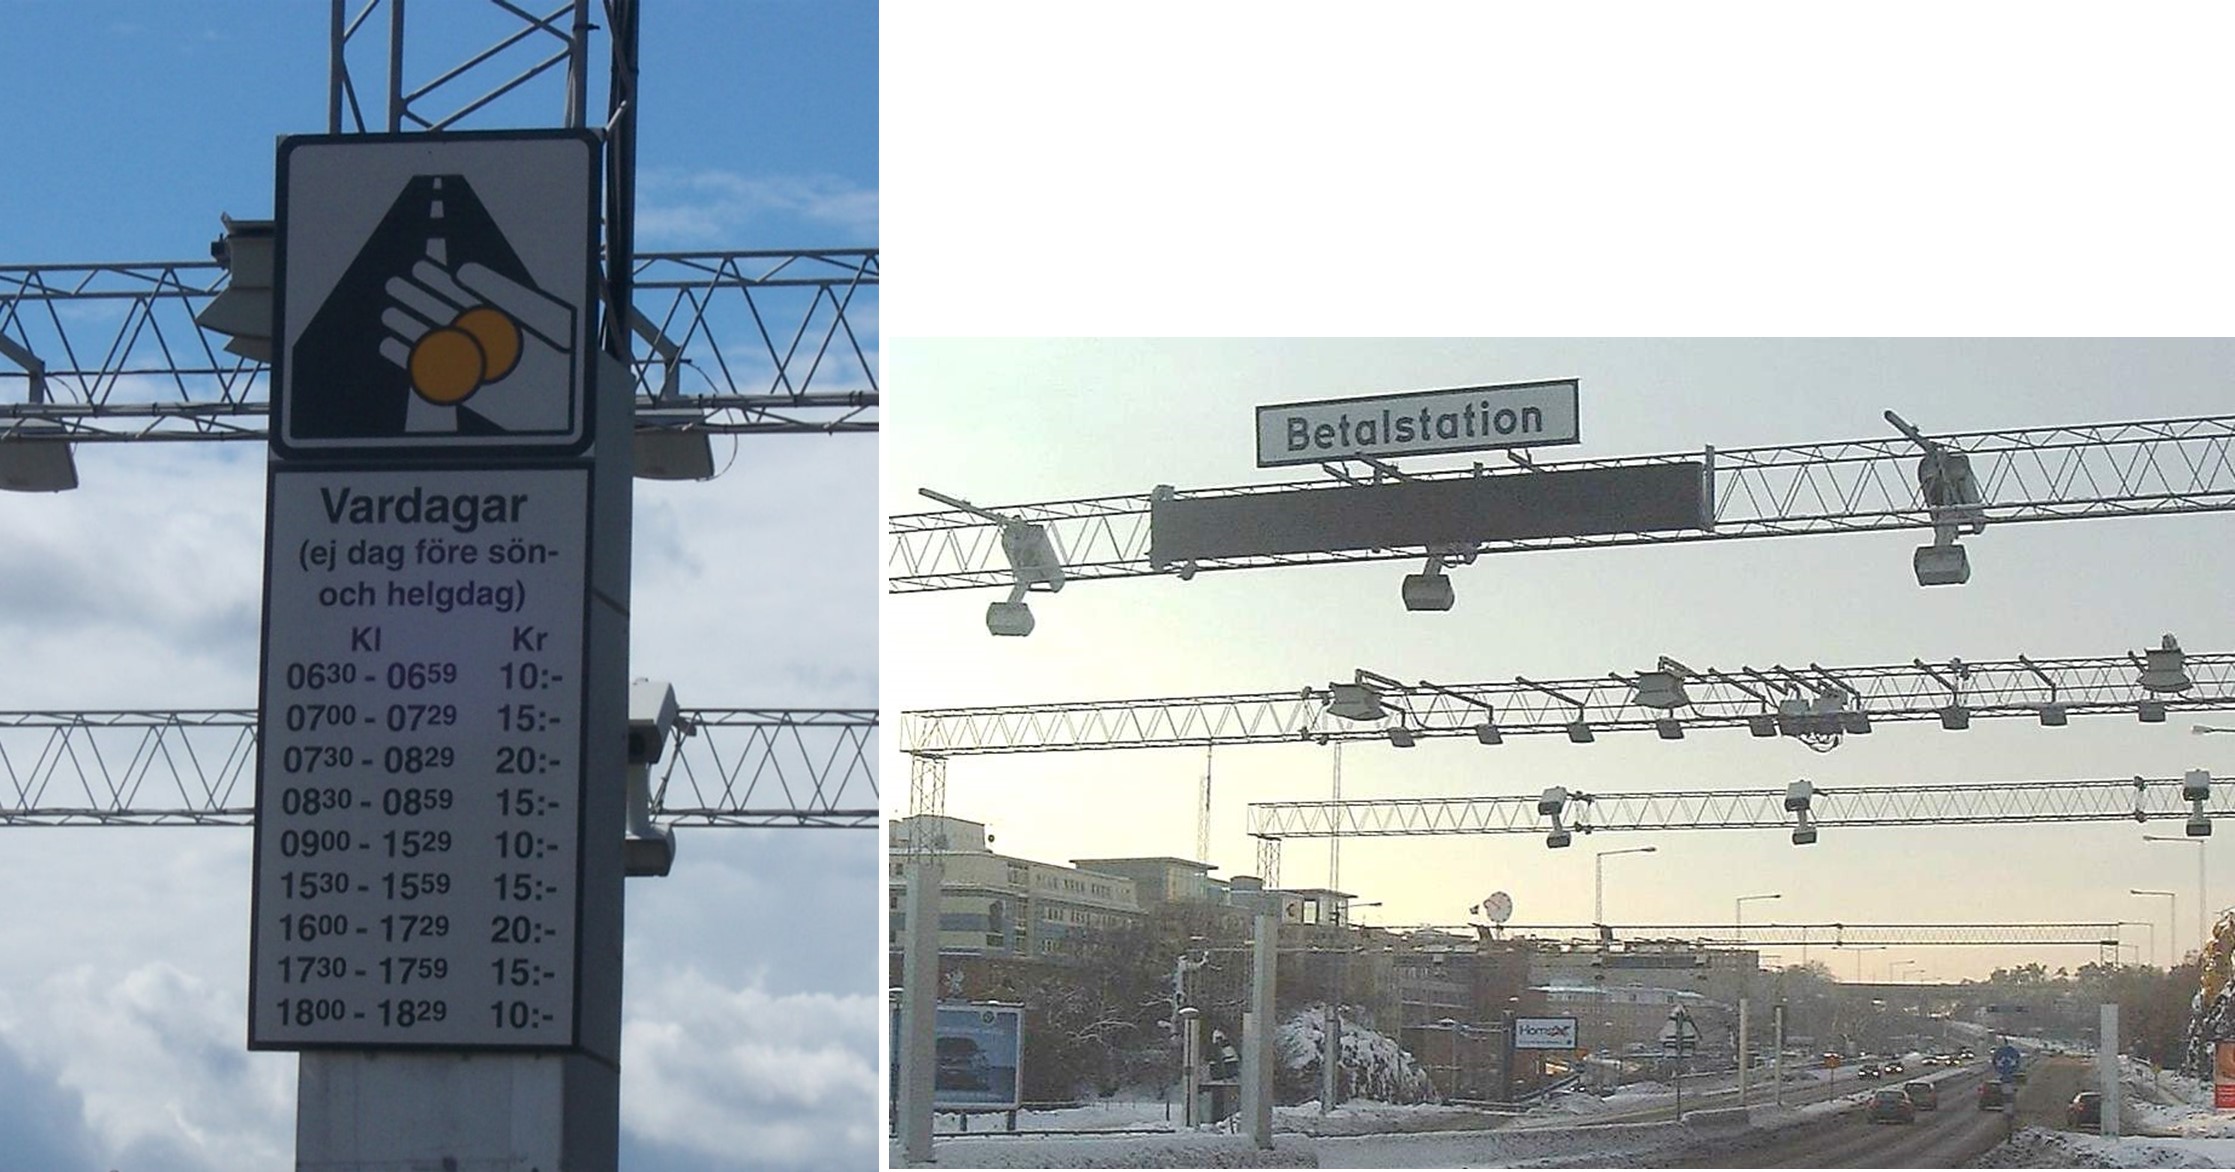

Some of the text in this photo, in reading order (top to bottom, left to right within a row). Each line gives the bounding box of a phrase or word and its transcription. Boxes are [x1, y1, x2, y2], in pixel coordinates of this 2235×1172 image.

[1286, 400, 1544, 452] Betalstation
[319, 486, 529, 534] Vardagar
[299, 538, 559, 573] (ej dag före sön-
[318, 579, 526, 614] och helgdag)
[351, 625, 549, 652] Kl Kr
[499, 661, 564, 690] 10:-
[497, 703, 561, 732] 15:-
[495, 746, 561, 775] 20:-
[496, 788, 560, 817] 15:-
[494, 830, 559, 859] 10:-
[493, 872, 558, 902] 15:-
[490, 915, 556, 945] 20:-
[491, 957, 555, 987] 15:-
[490, 1000, 554, 1030] 10:-
